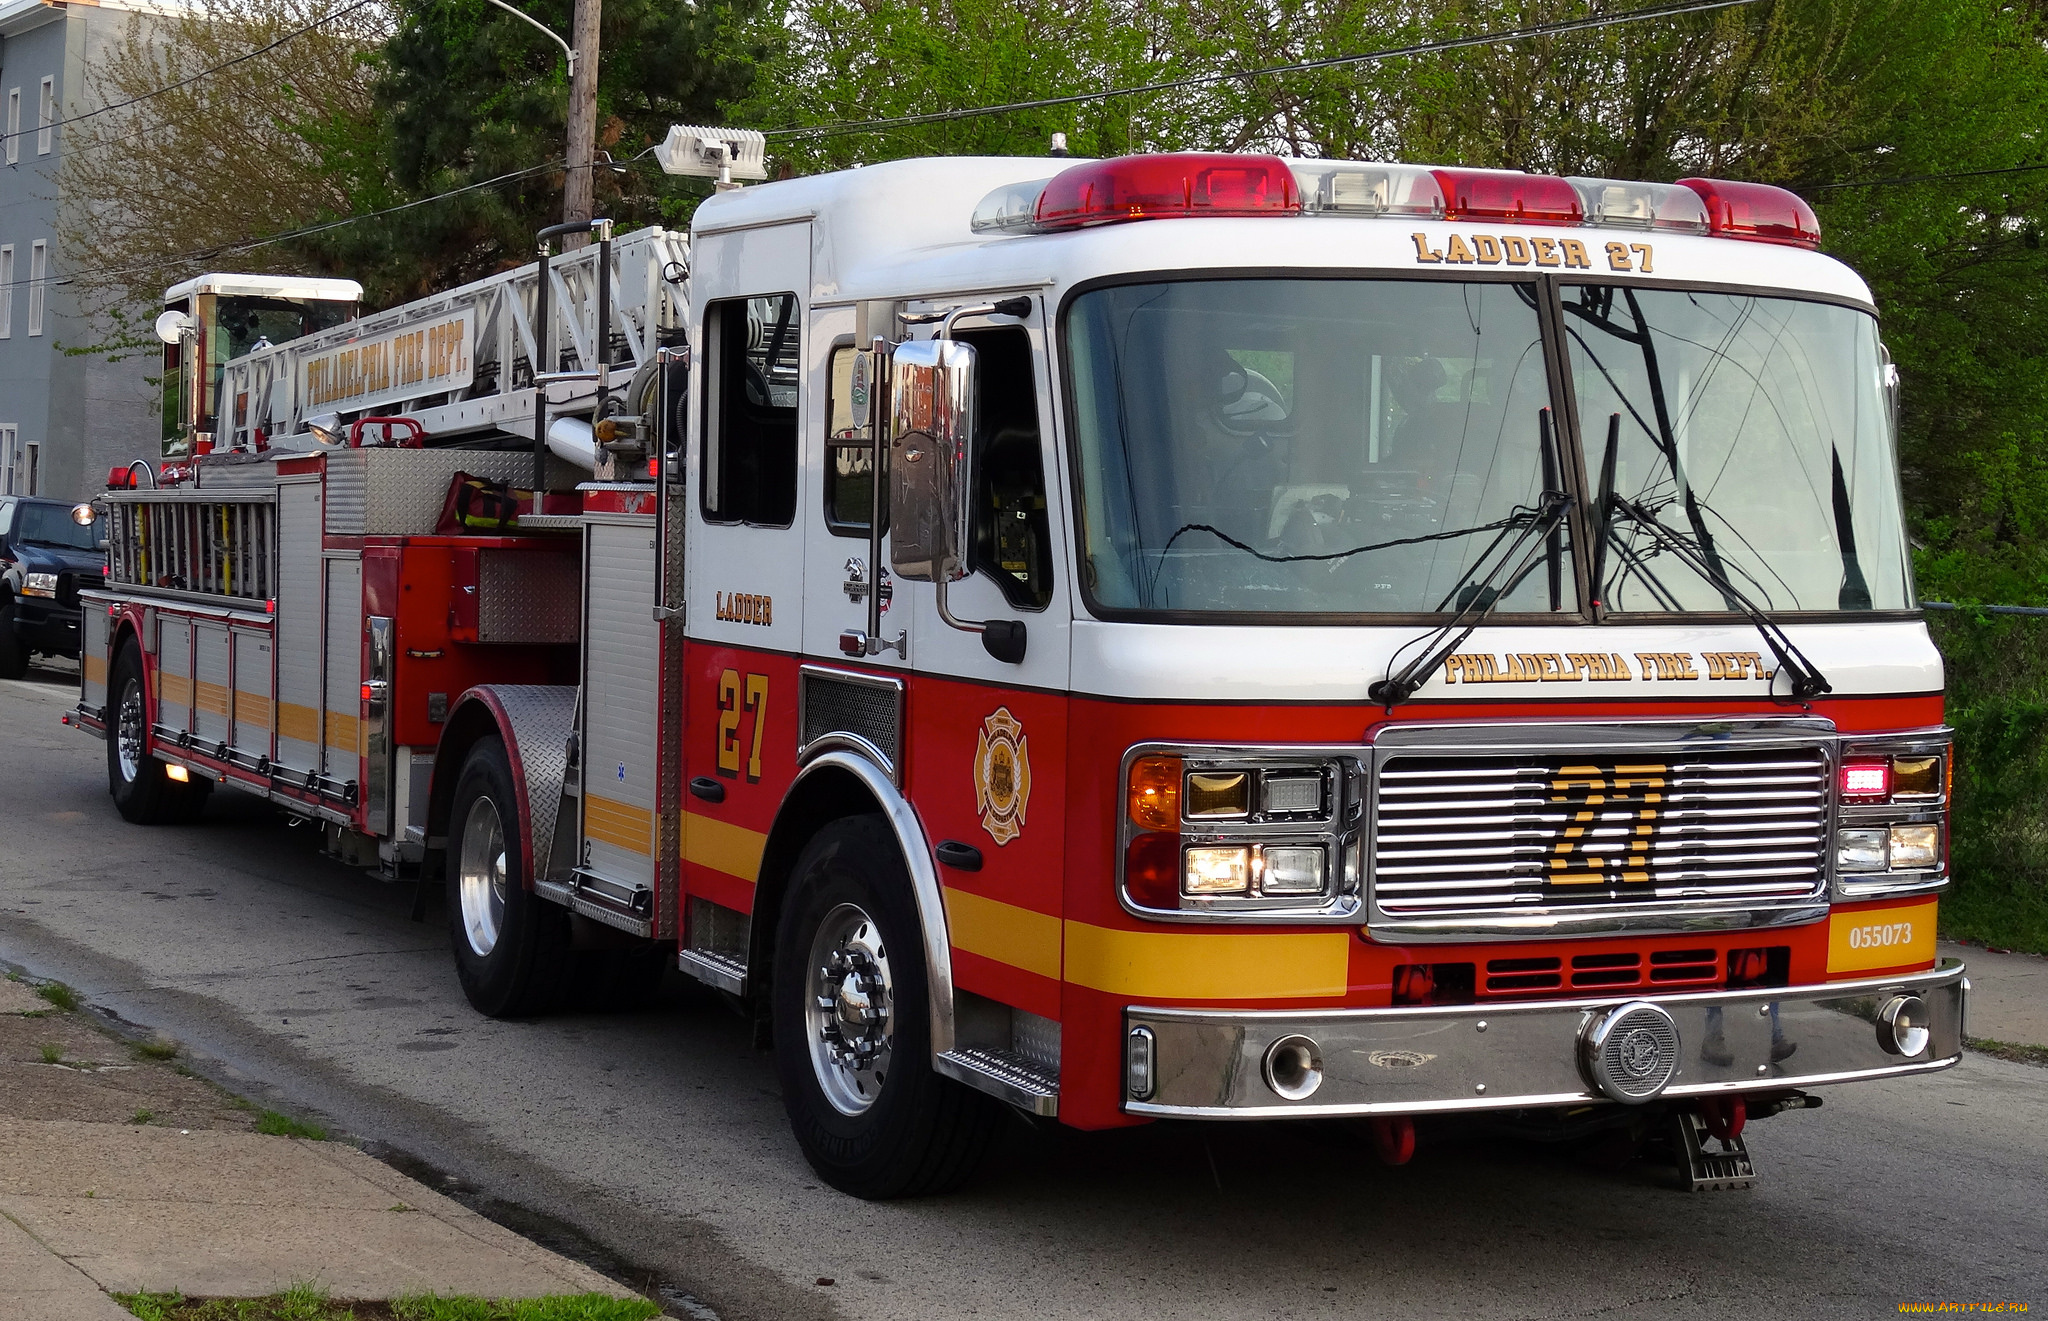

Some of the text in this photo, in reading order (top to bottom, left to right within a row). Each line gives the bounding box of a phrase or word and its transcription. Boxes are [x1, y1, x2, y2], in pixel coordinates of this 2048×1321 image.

[1411, 233, 1654, 273] LADDER 27
[307, 319, 467, 409] PHILADELPHIA FIRE DEPT.
[716, 591, 772, 626] LADDER
[1445, 652, 1773, 684] PHILADELPHIA FIRE DEPT.
[716, 668, 769, 784] 27
[1548, 764, 1667, 885] 27
[584, 840, 592, 865] 2
[1849, 922, 1912, 949] 055073
